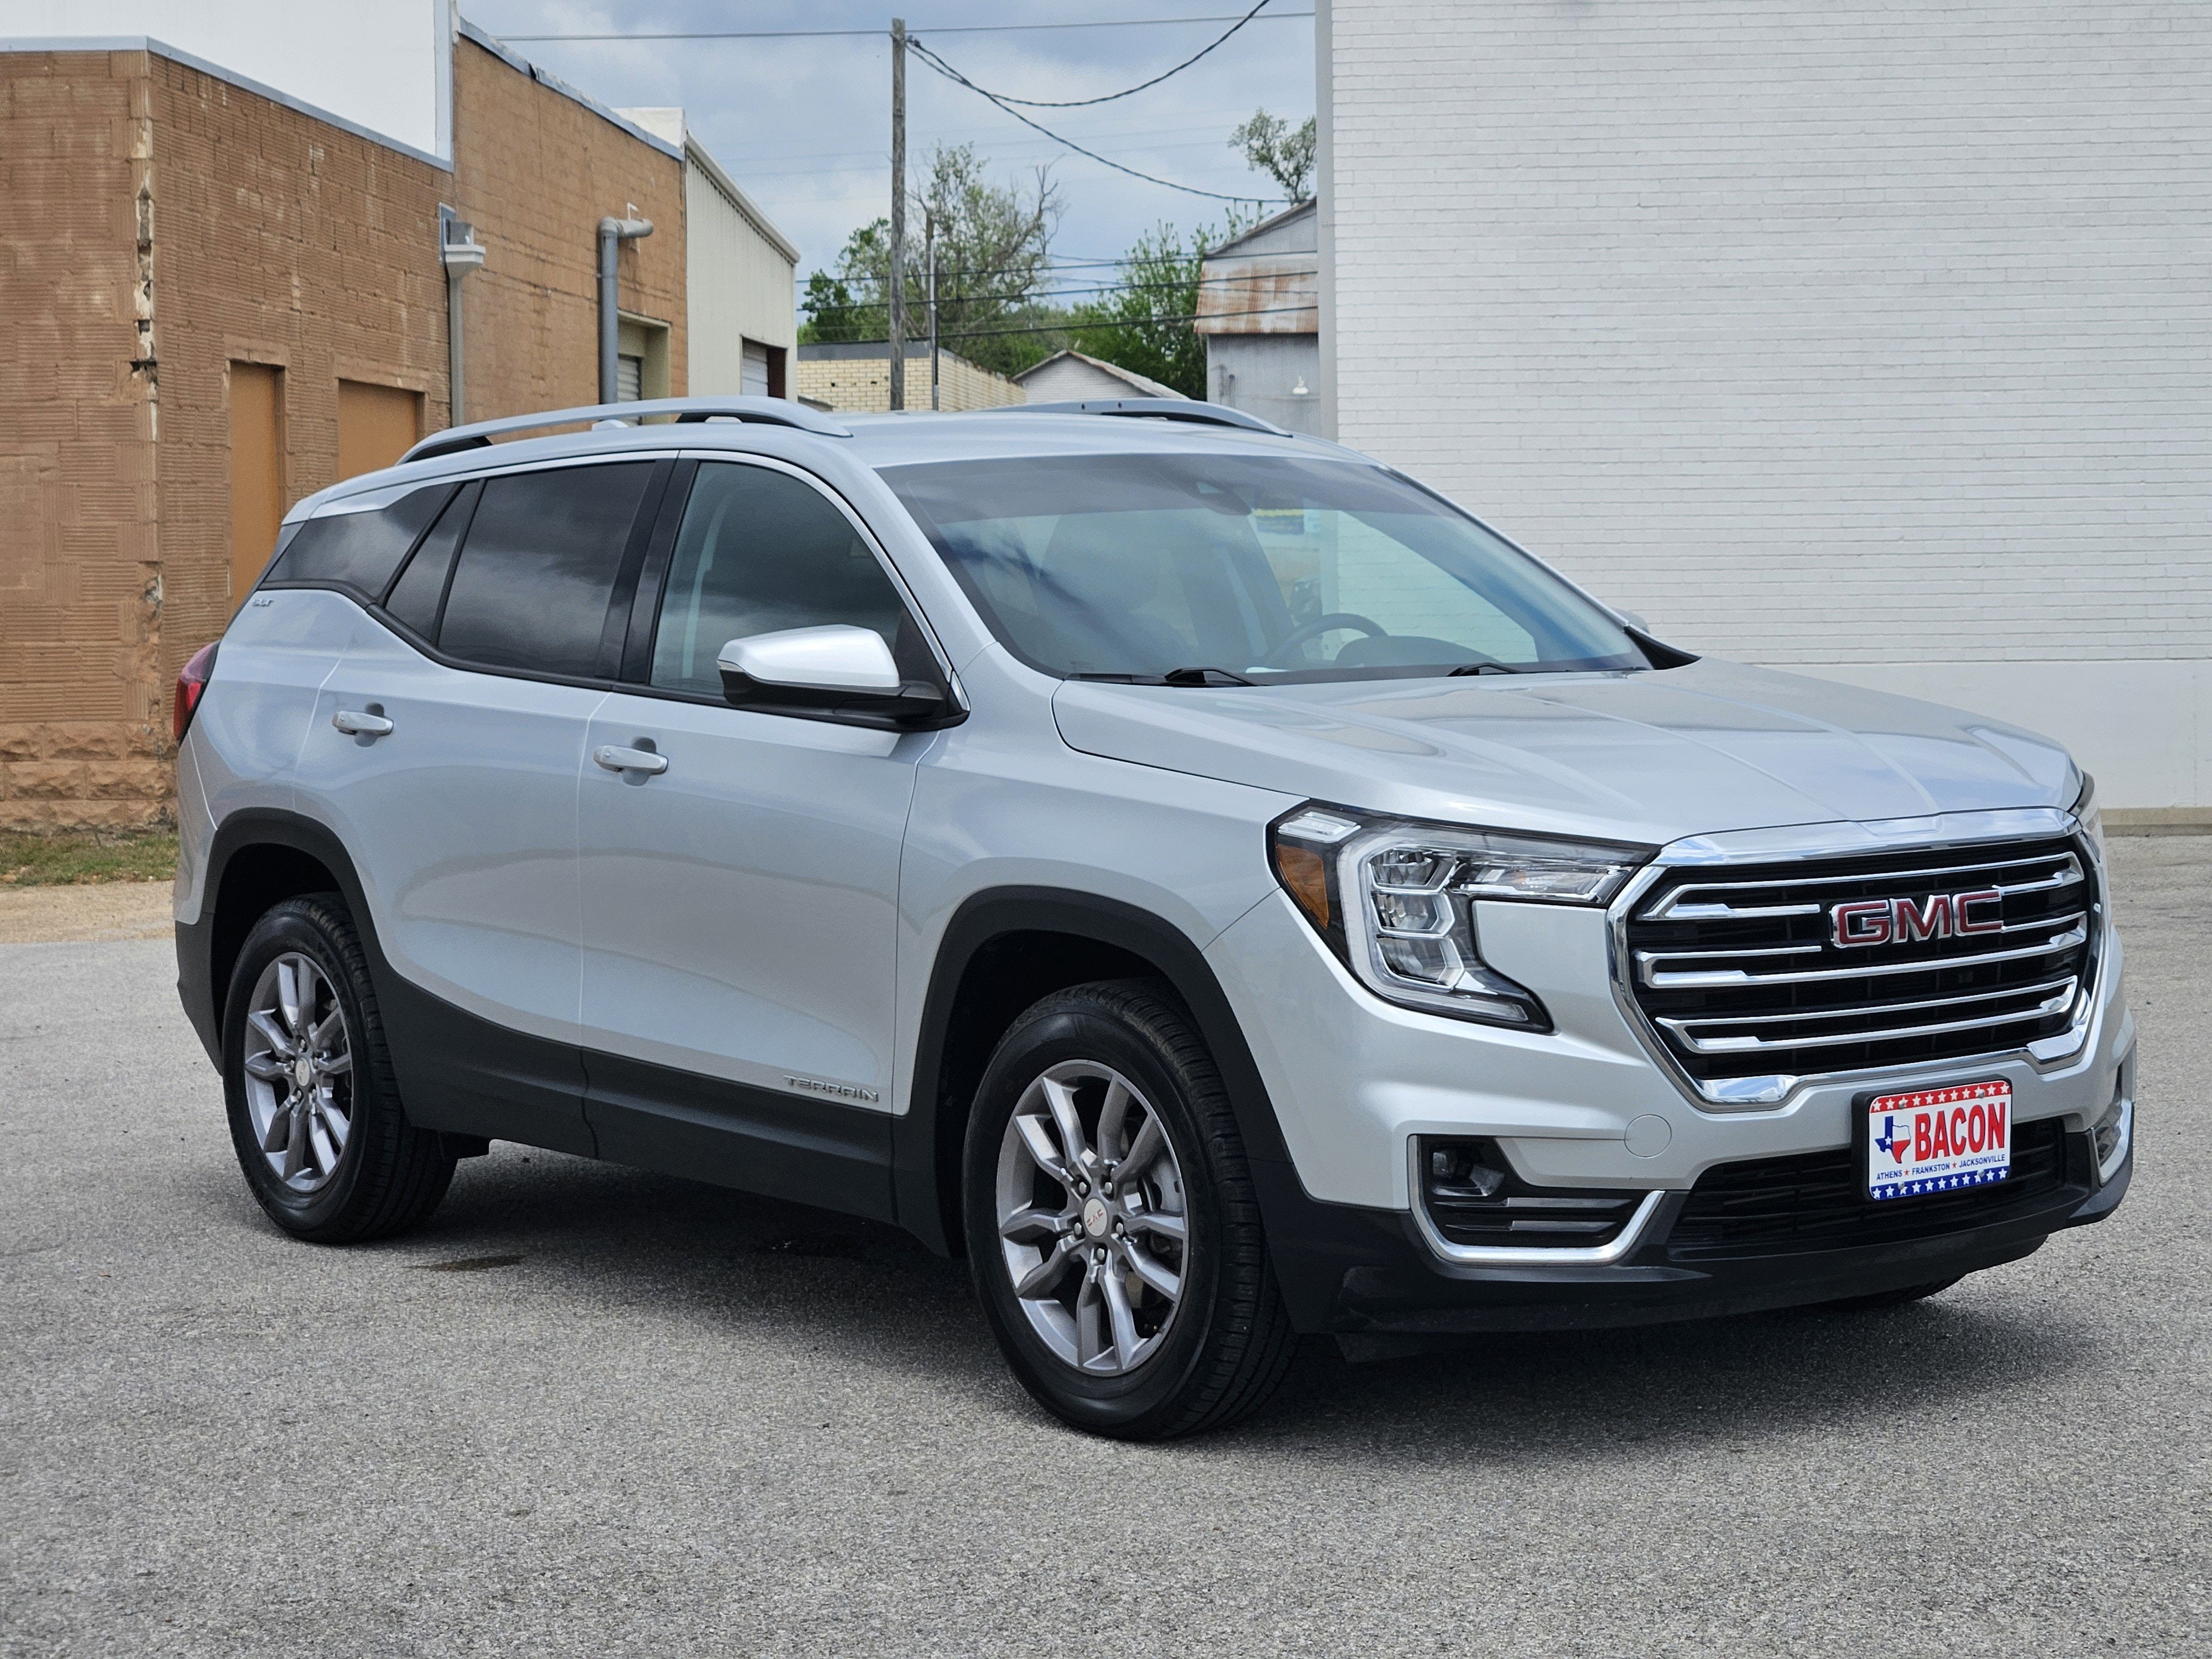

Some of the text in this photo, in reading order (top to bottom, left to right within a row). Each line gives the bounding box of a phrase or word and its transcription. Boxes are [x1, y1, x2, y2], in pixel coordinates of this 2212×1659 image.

[1830, 889, 2004, 948] GMC
[783, 1074, 879, 1103] TERRAIN
[1914, 1101, 2006, 1162] BACON
[1876, 1154, 2006, 1181] ATHENS FRANKSTON JACKSONVILLE
